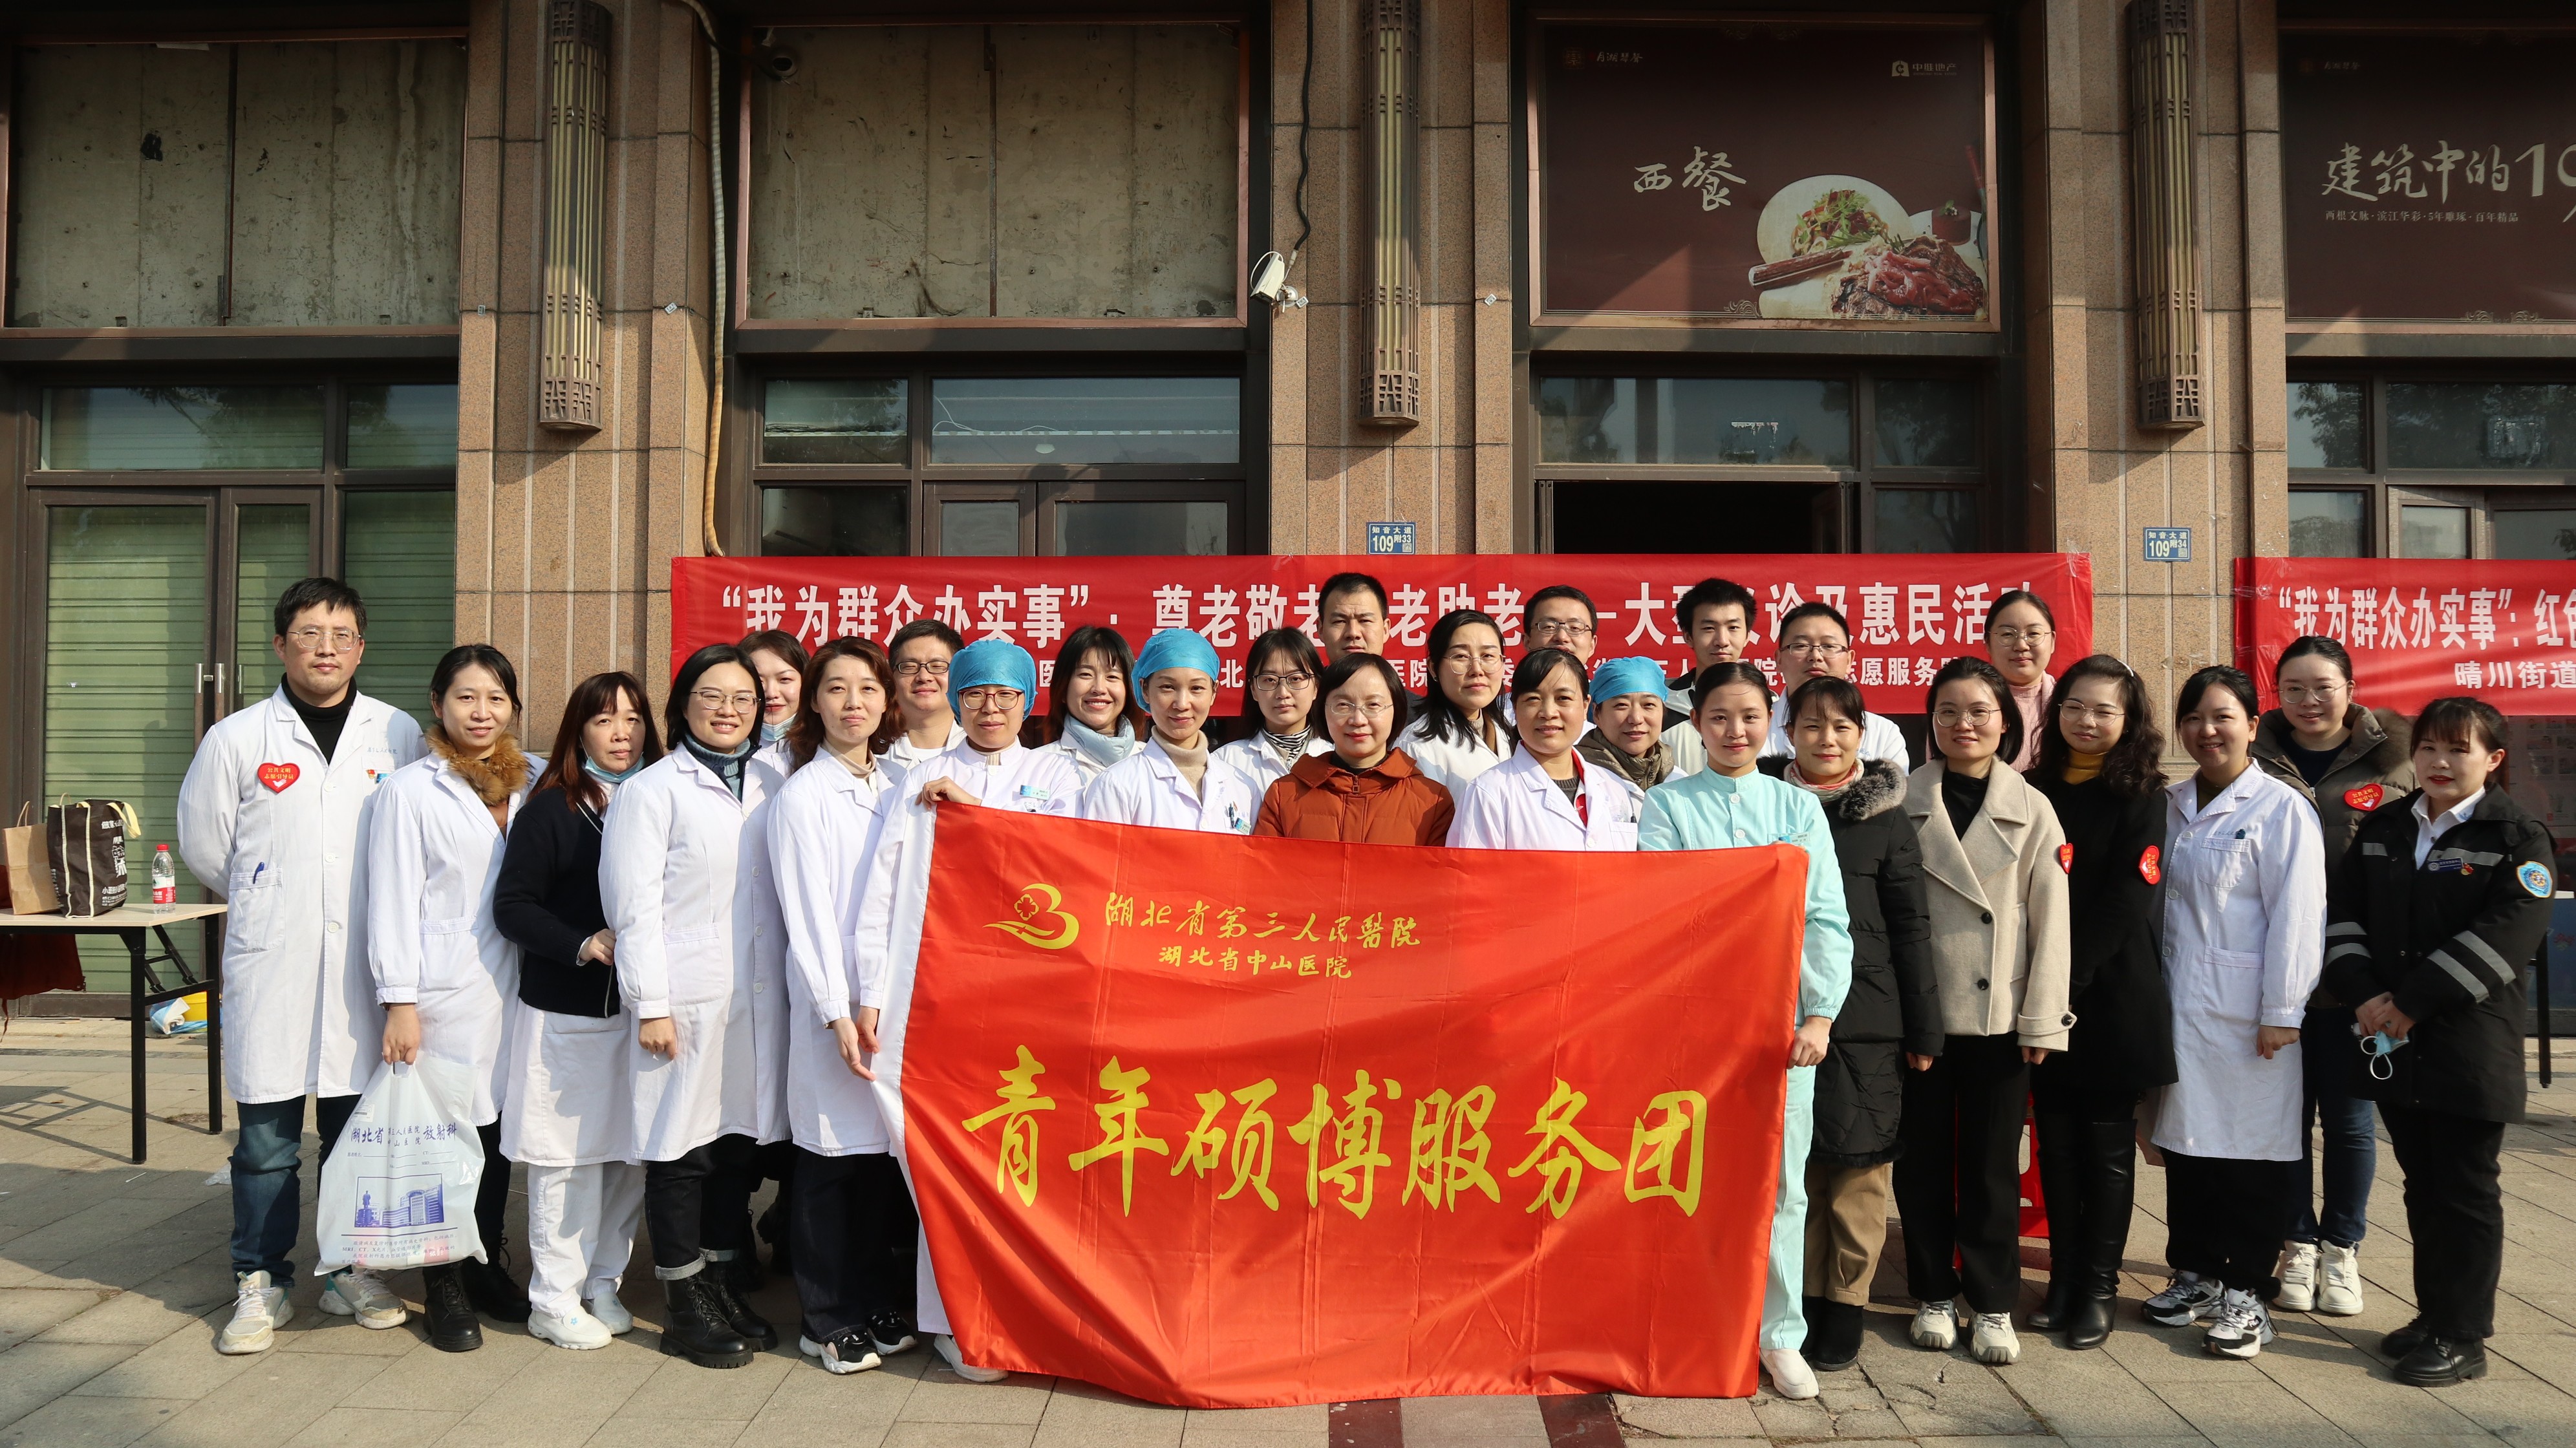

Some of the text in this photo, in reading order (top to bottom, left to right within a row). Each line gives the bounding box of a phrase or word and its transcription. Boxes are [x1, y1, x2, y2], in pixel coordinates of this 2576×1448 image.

[1634, 145, 1746, 211] 西餐
[2454, 661, 2576, 689] 晴川街道
[1158, 946, 1353, 979] 湖北省中山医院
[423, 1122, 457, 1141] 放射科
[961, 1045, 1709, 1220] 青年硕博服务团
